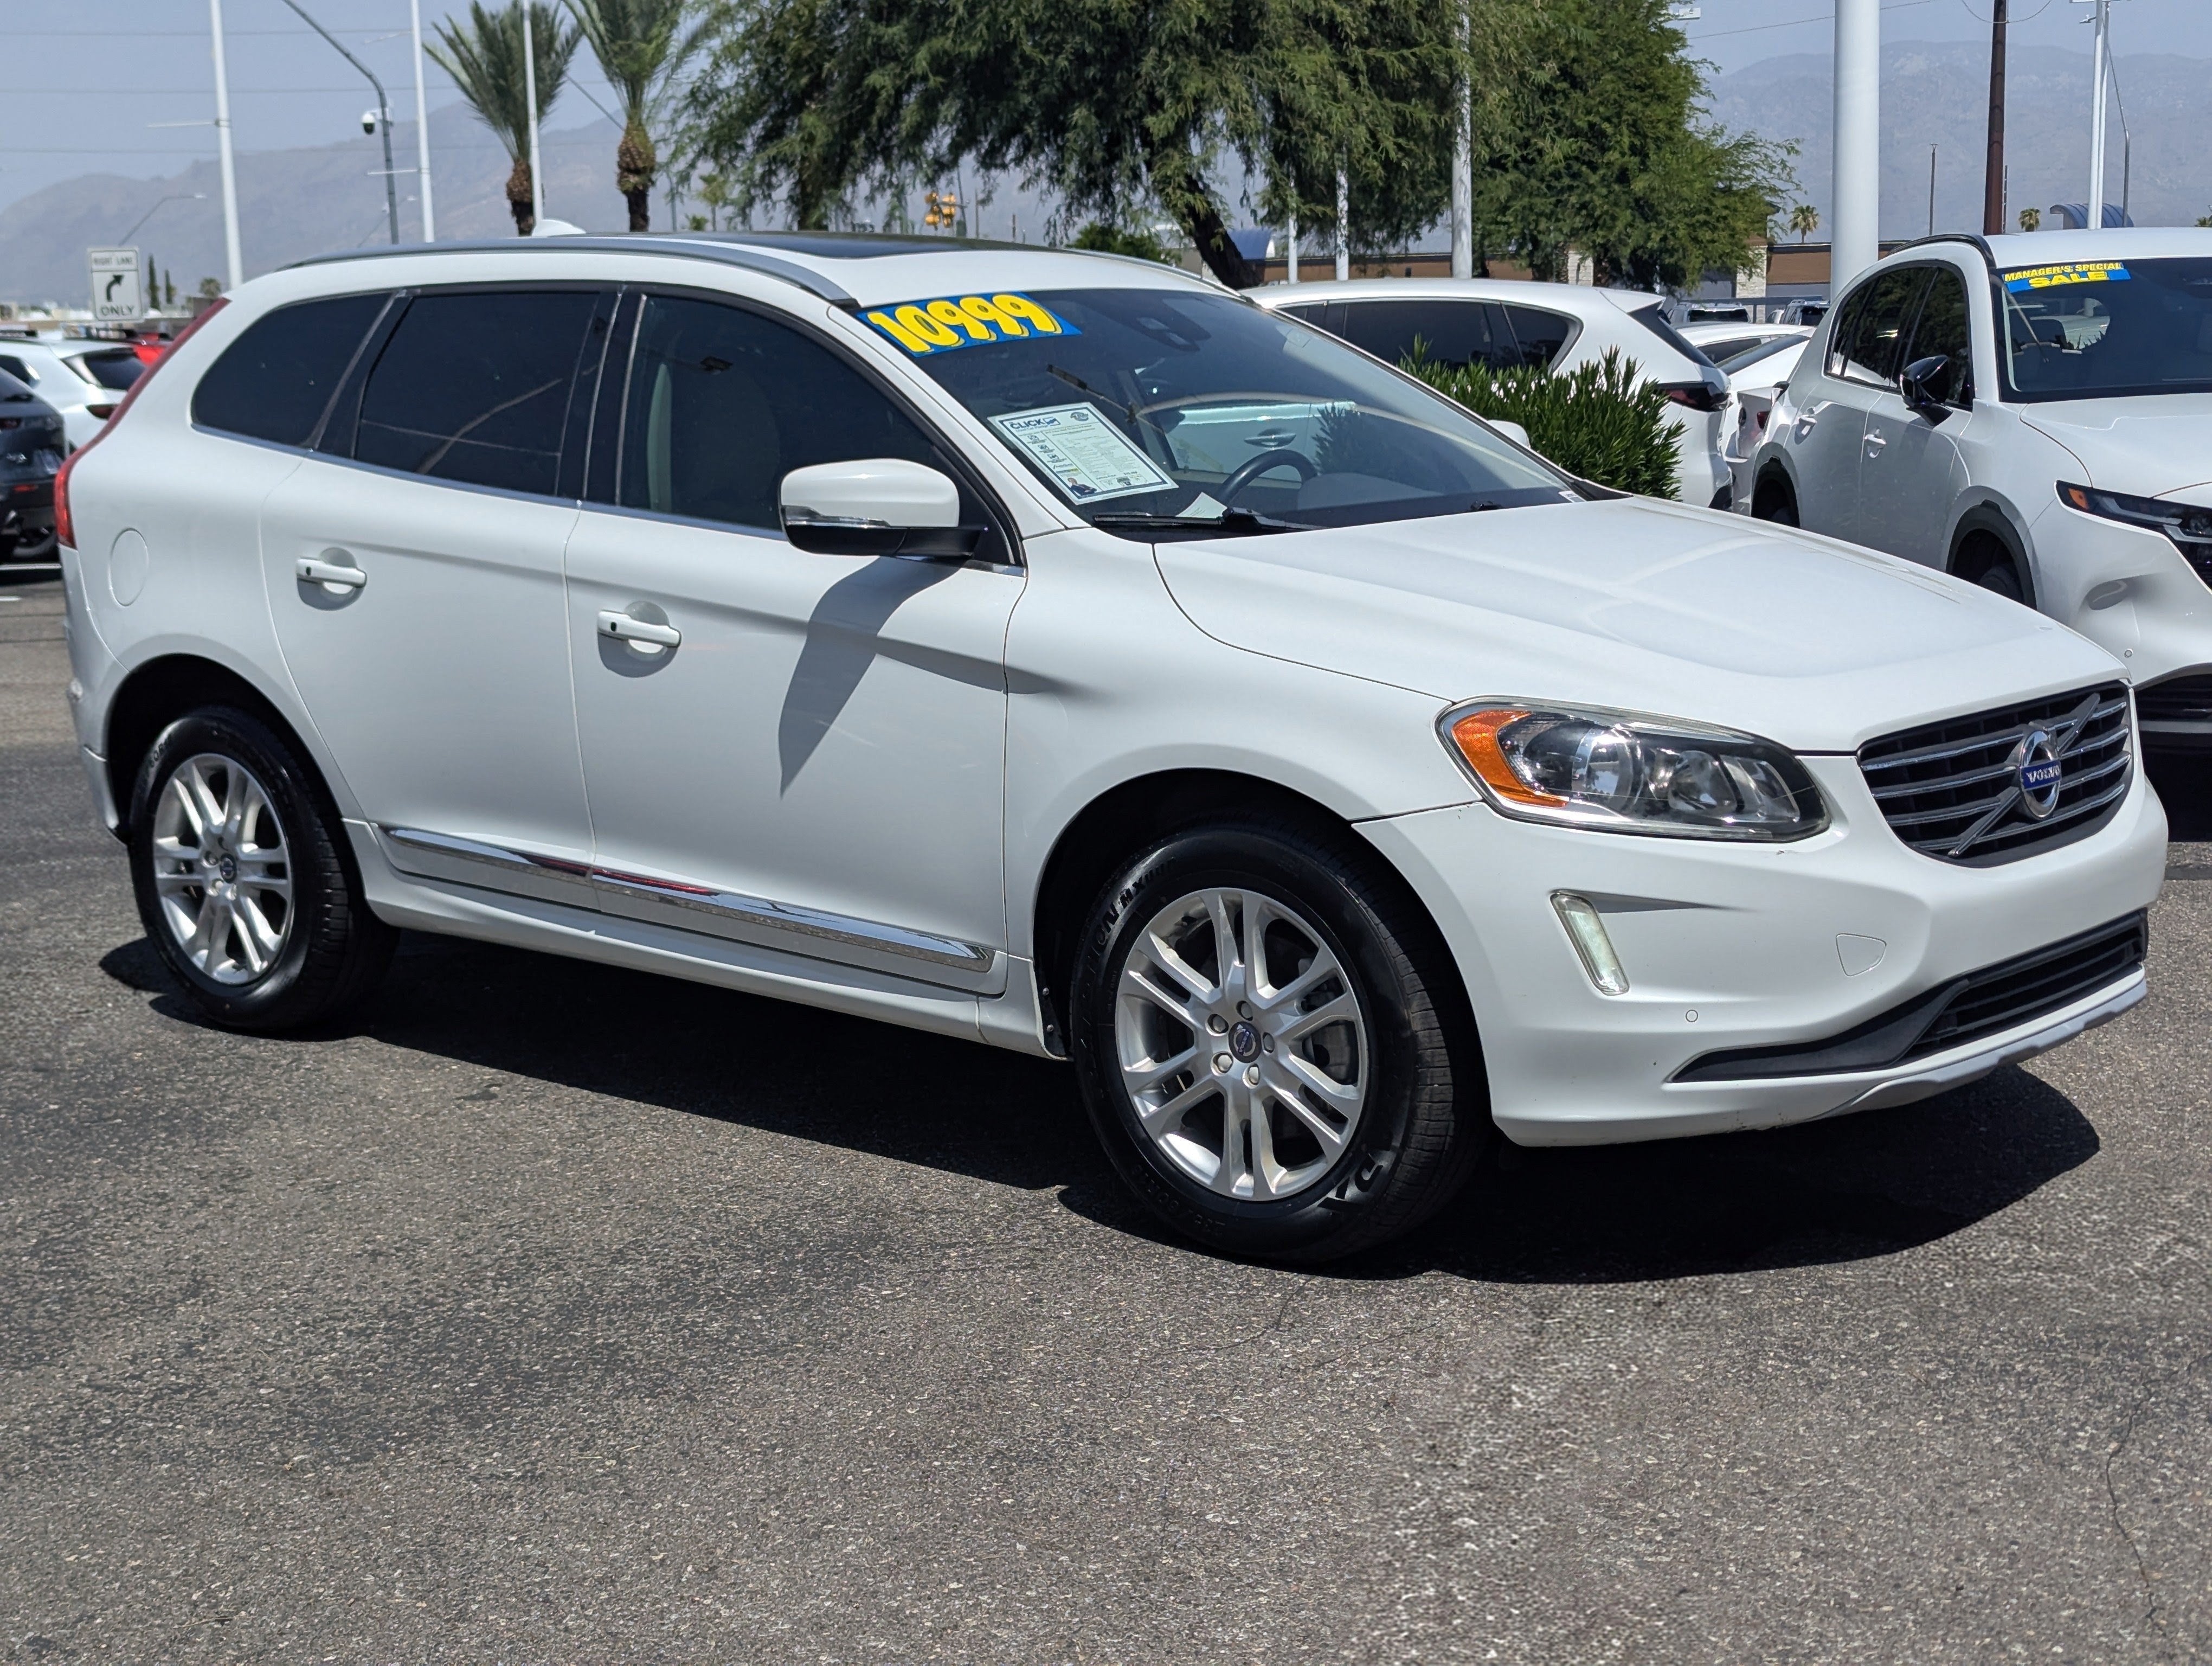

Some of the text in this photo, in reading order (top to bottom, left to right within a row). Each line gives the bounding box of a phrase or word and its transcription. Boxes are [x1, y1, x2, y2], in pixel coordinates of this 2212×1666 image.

[2004, 262, 2124, 281] MANAGER'S SPECIAL
[2029, 271, 2110, 287] SALE
[101, 305, 134, 316] ONLY
[867, 294, 1062, 353] 10999
[1010, 419, 1045, 429] CLICK
[2026, 765, 2060, 783] VOLVO
